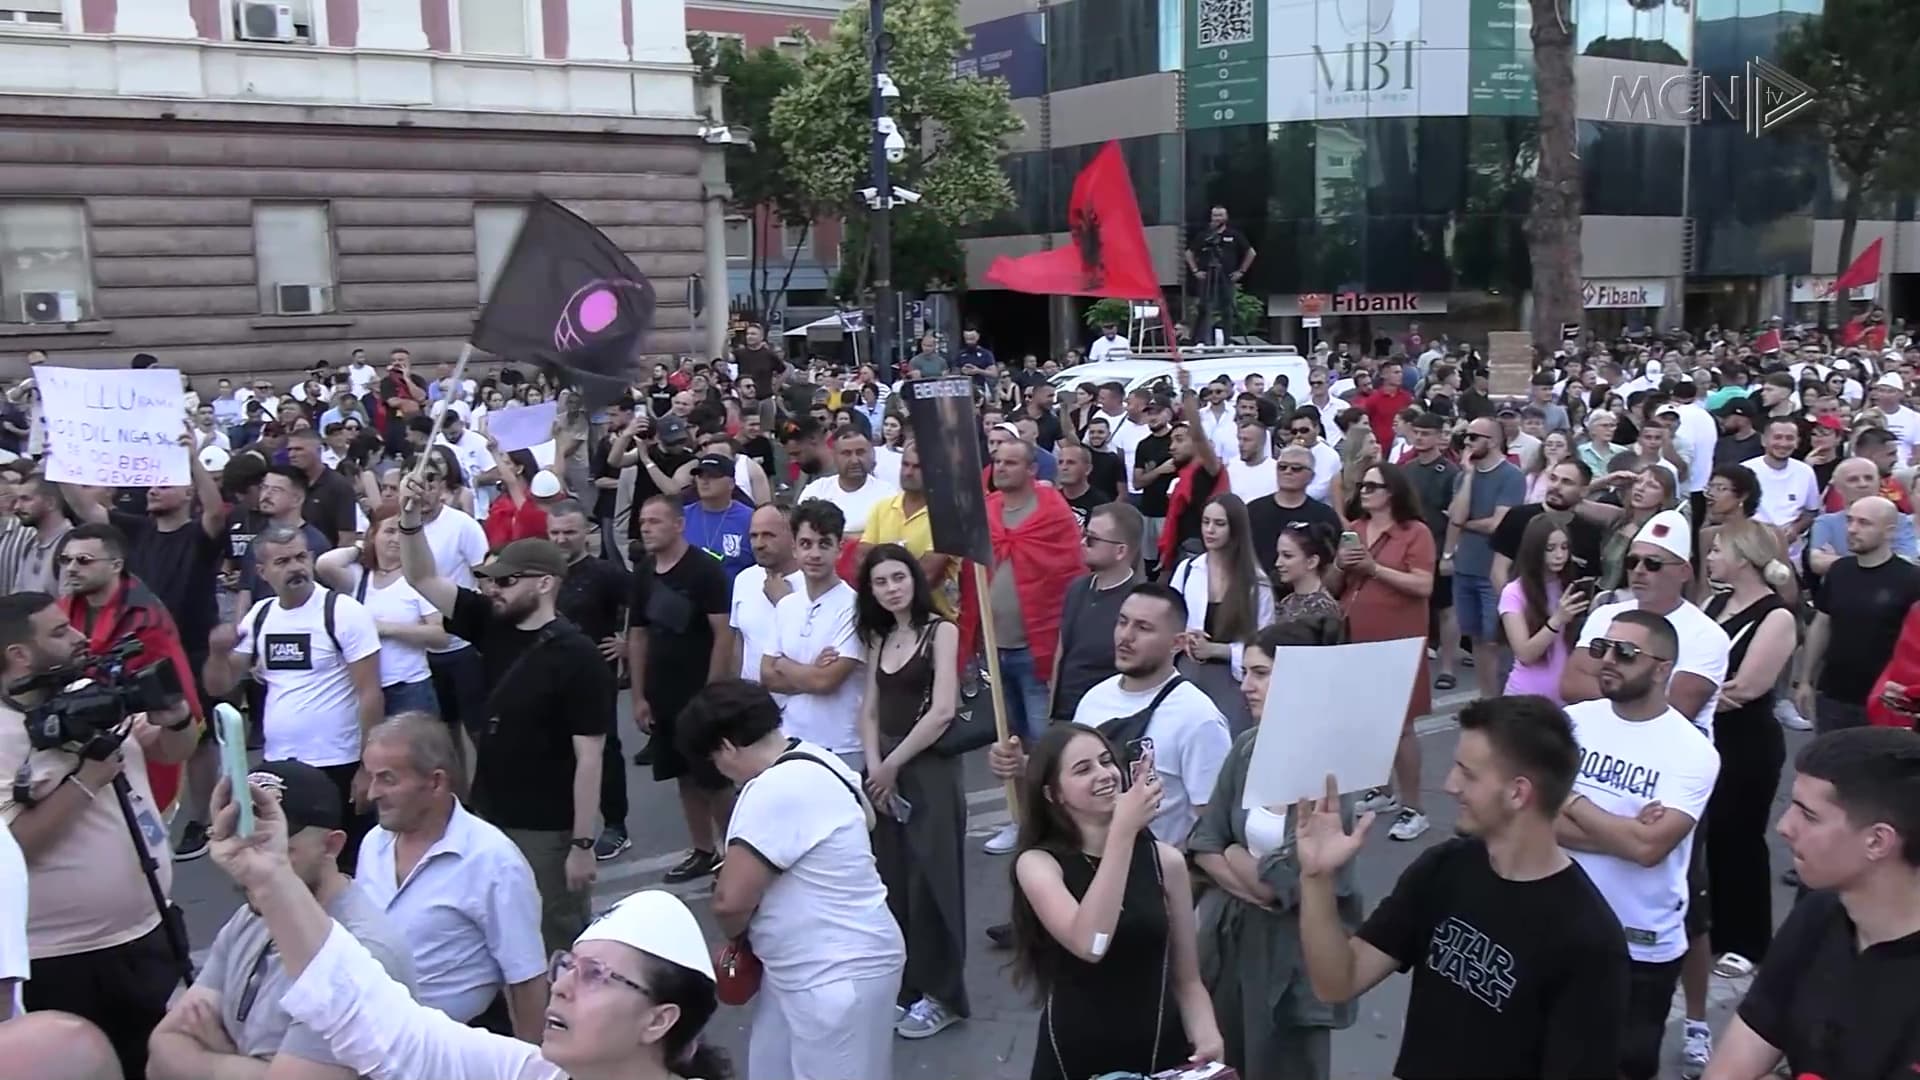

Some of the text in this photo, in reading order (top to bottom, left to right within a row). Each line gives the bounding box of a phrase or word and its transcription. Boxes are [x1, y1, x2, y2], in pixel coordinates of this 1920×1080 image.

[1311, 39, 1427, 92] MBT
[1331, 293, 1417, 313] Fibank
[1597, 286, 1648, 304] Fibank
[270, 642, 305, 656] KARL
[1432, 916, 1517, 989] STAR
[1425, 939, 1513, 1009] WARS
